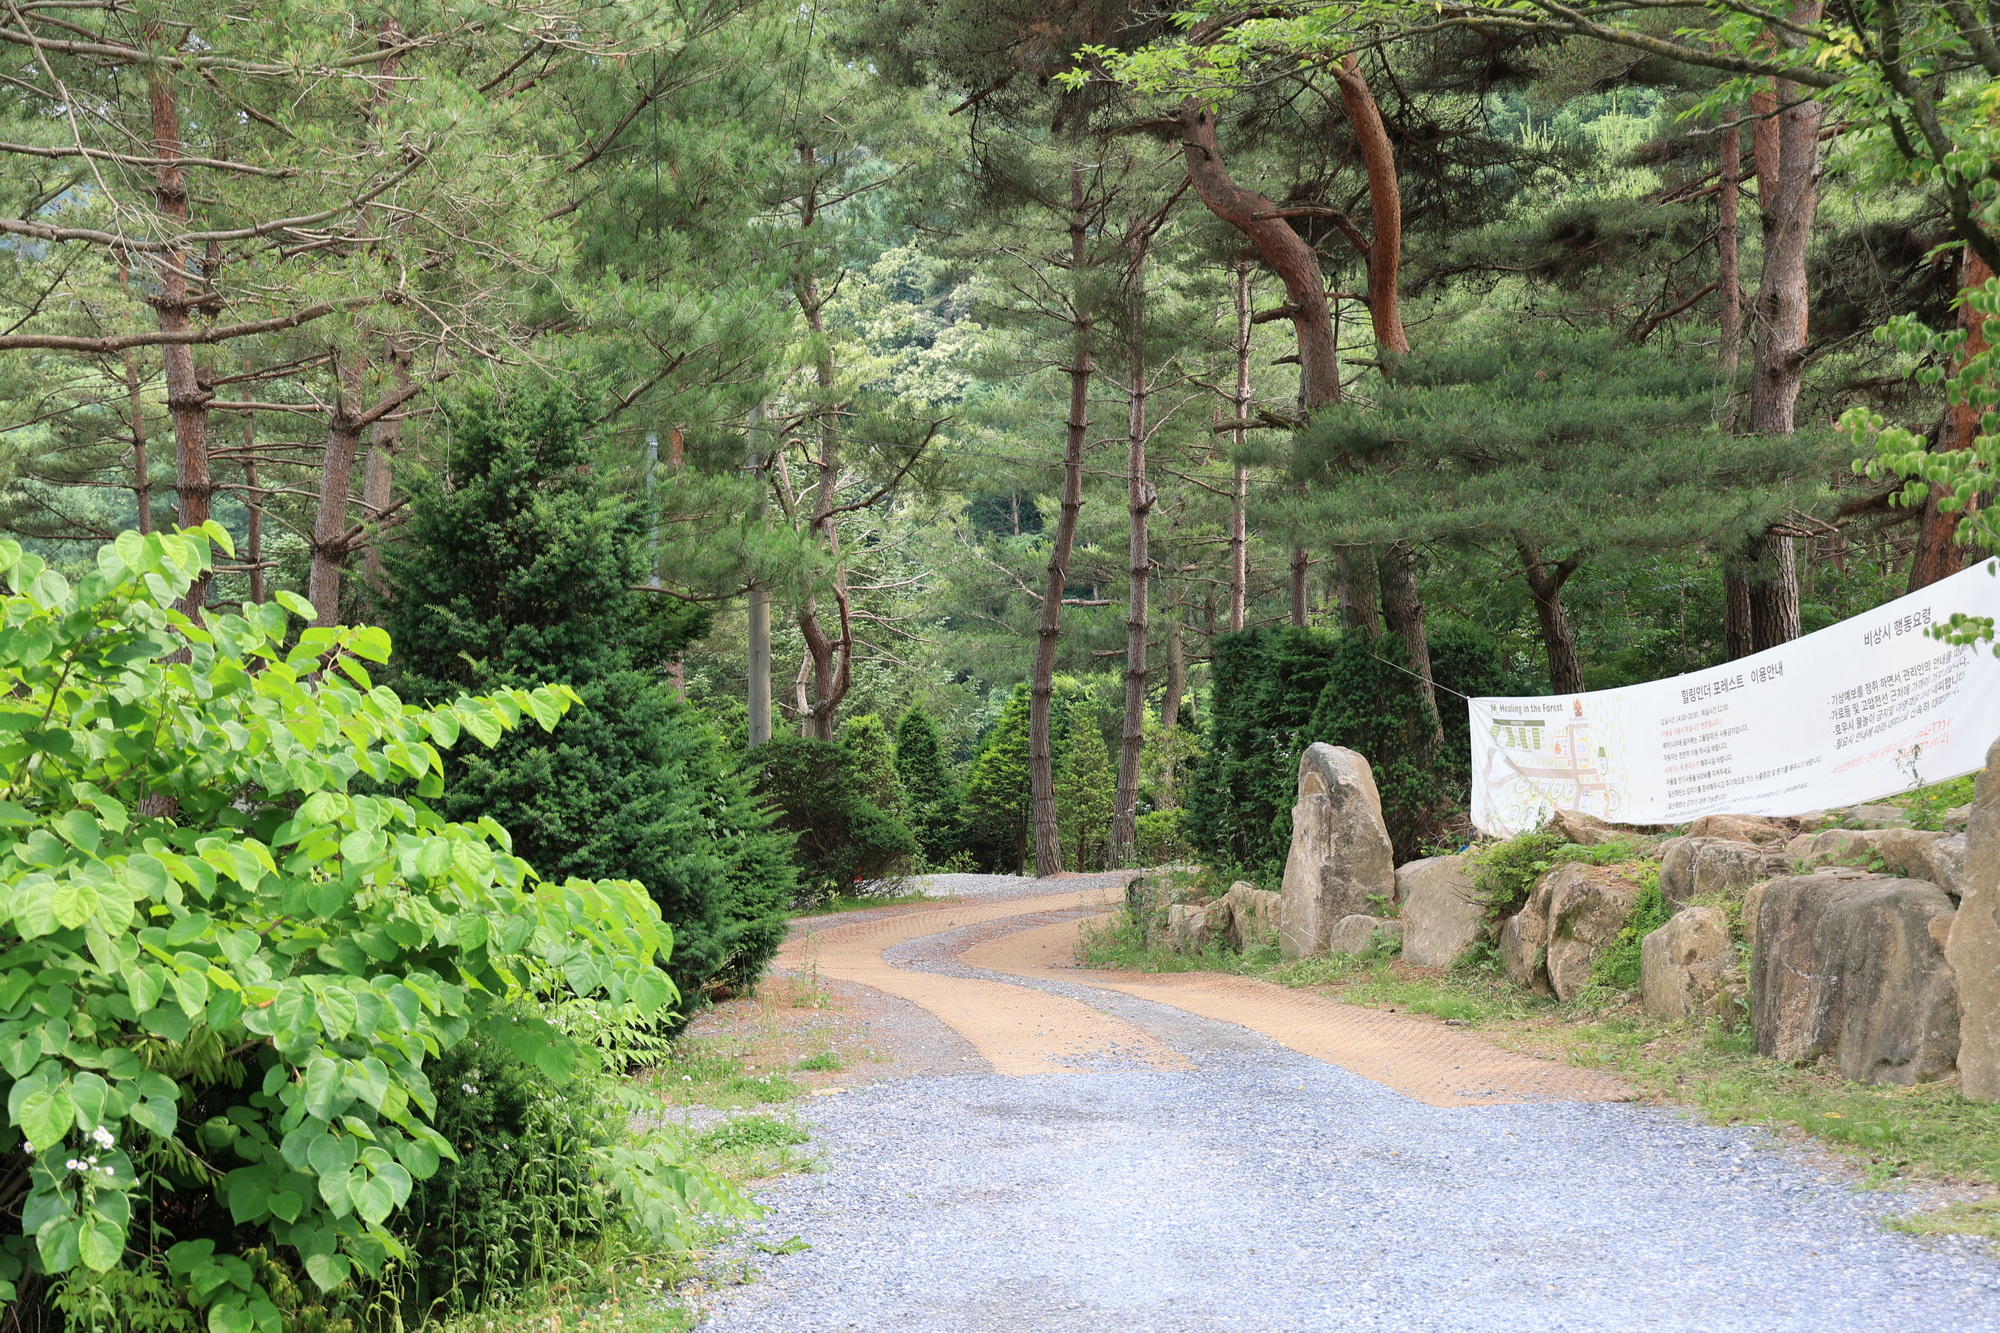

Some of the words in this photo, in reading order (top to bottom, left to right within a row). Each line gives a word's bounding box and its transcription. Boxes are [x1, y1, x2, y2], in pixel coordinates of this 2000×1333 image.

[1864, 623, 1891, 646] 비상시
[1894, 606, 1932, 636] 행동요령
[1681, 684, 1712, 704] 힐링인더
[1713, 674, 1744, 695] 포레스트
[1751, 660, 1784, 684] 이용안내
[1831, 685, 1863, 705] 기상예보를
[1880, 672, 1902, 688] 하면서
[1903, 660, 1931, 681] 관리인의
[1932, 651, 1952, 669] 안내를
[1500, 704, 1522, 715] Healing
[1523, 704, 1529, 712] in
[1530, 704, 1541, 712] the
[1542, 703, 1563, 712] Forest
[1852, 702, 1860, 715] 및
[1861, 692, 1888, 711] 고압전선
[1890, 684, 1910, 702] 근처에
[1855, 726, 1874, 743] 안내에
[1874, 721, 1887, 734] 따라
[1910, 700, 1930, 718] 신속히
[1856, 712, 1875, 729] 물놀이
